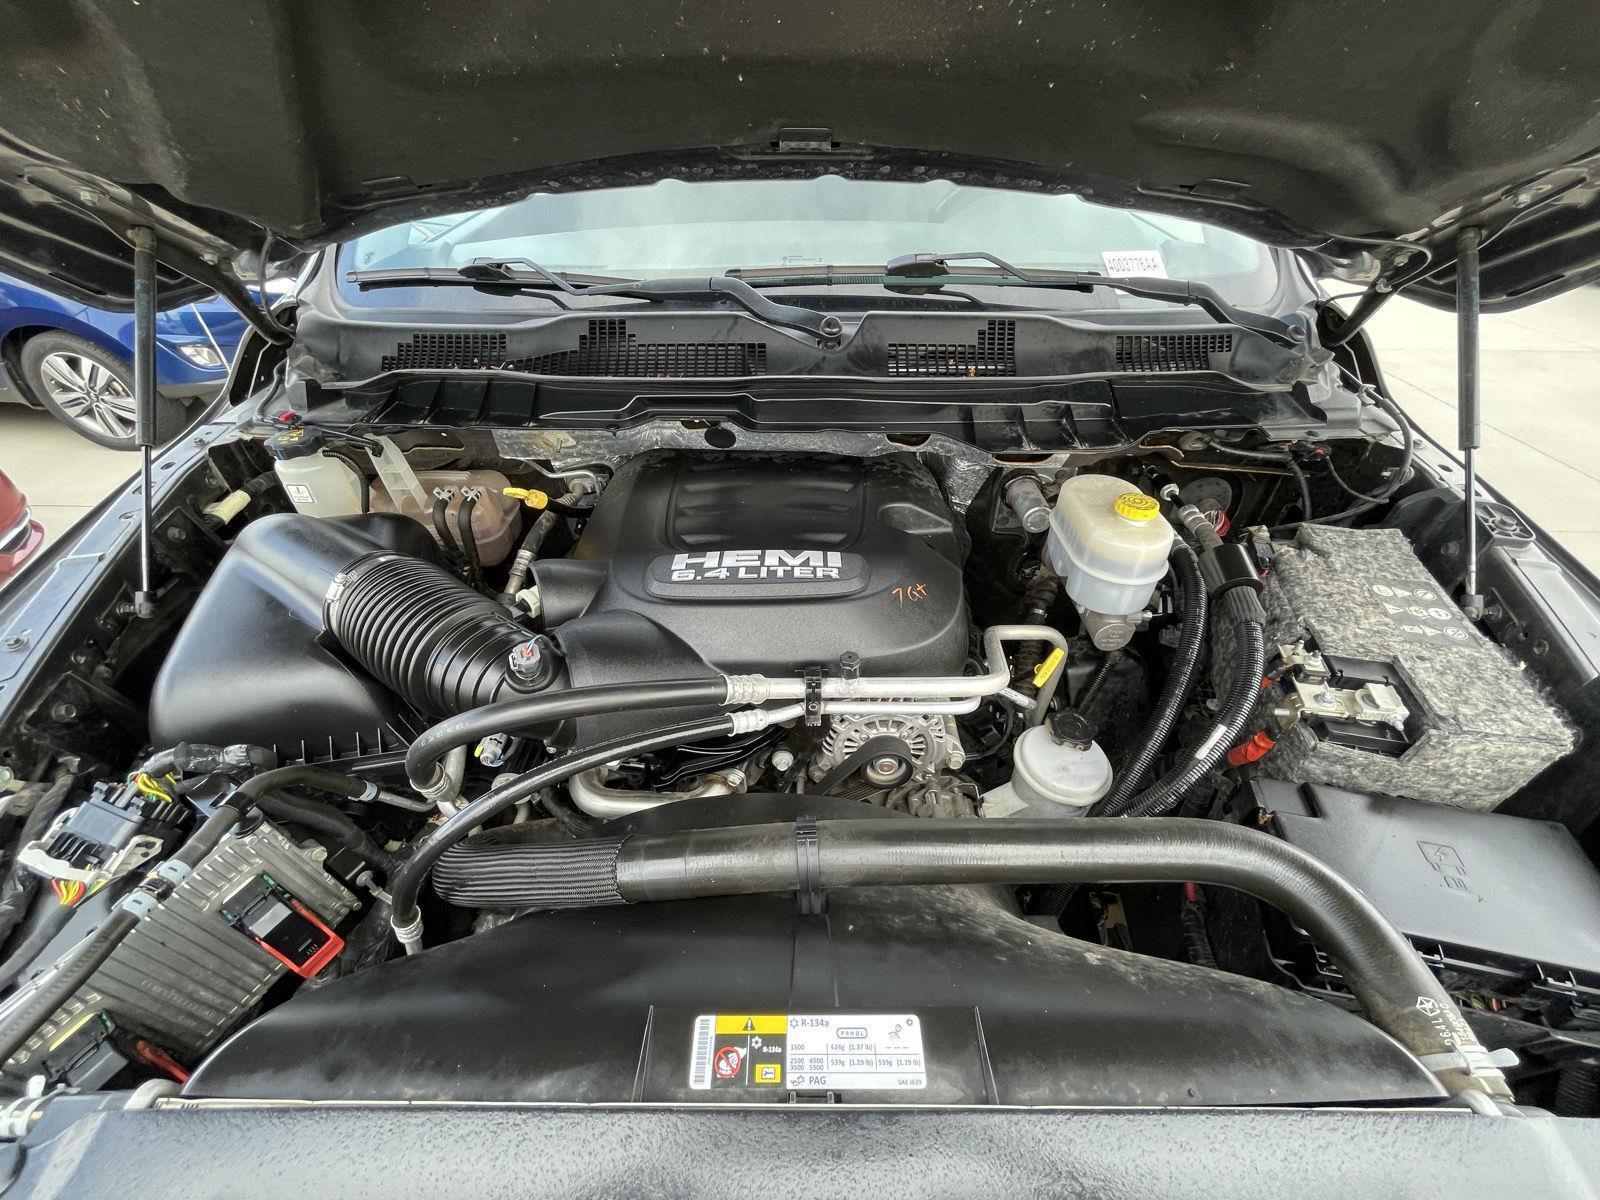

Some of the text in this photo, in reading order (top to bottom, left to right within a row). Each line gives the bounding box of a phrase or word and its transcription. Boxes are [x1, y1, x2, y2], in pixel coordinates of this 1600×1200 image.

[671, 549, 843, 571] HEMI
[671, 566, 840, 582] 6.4 LITER
[801, 1018, 830, 1028] R-134a
[830, 1059, 845, 1067] 539g
[878, 1059, 893, 1067] 539g
[809, 1076, 827, 1085] PAG
